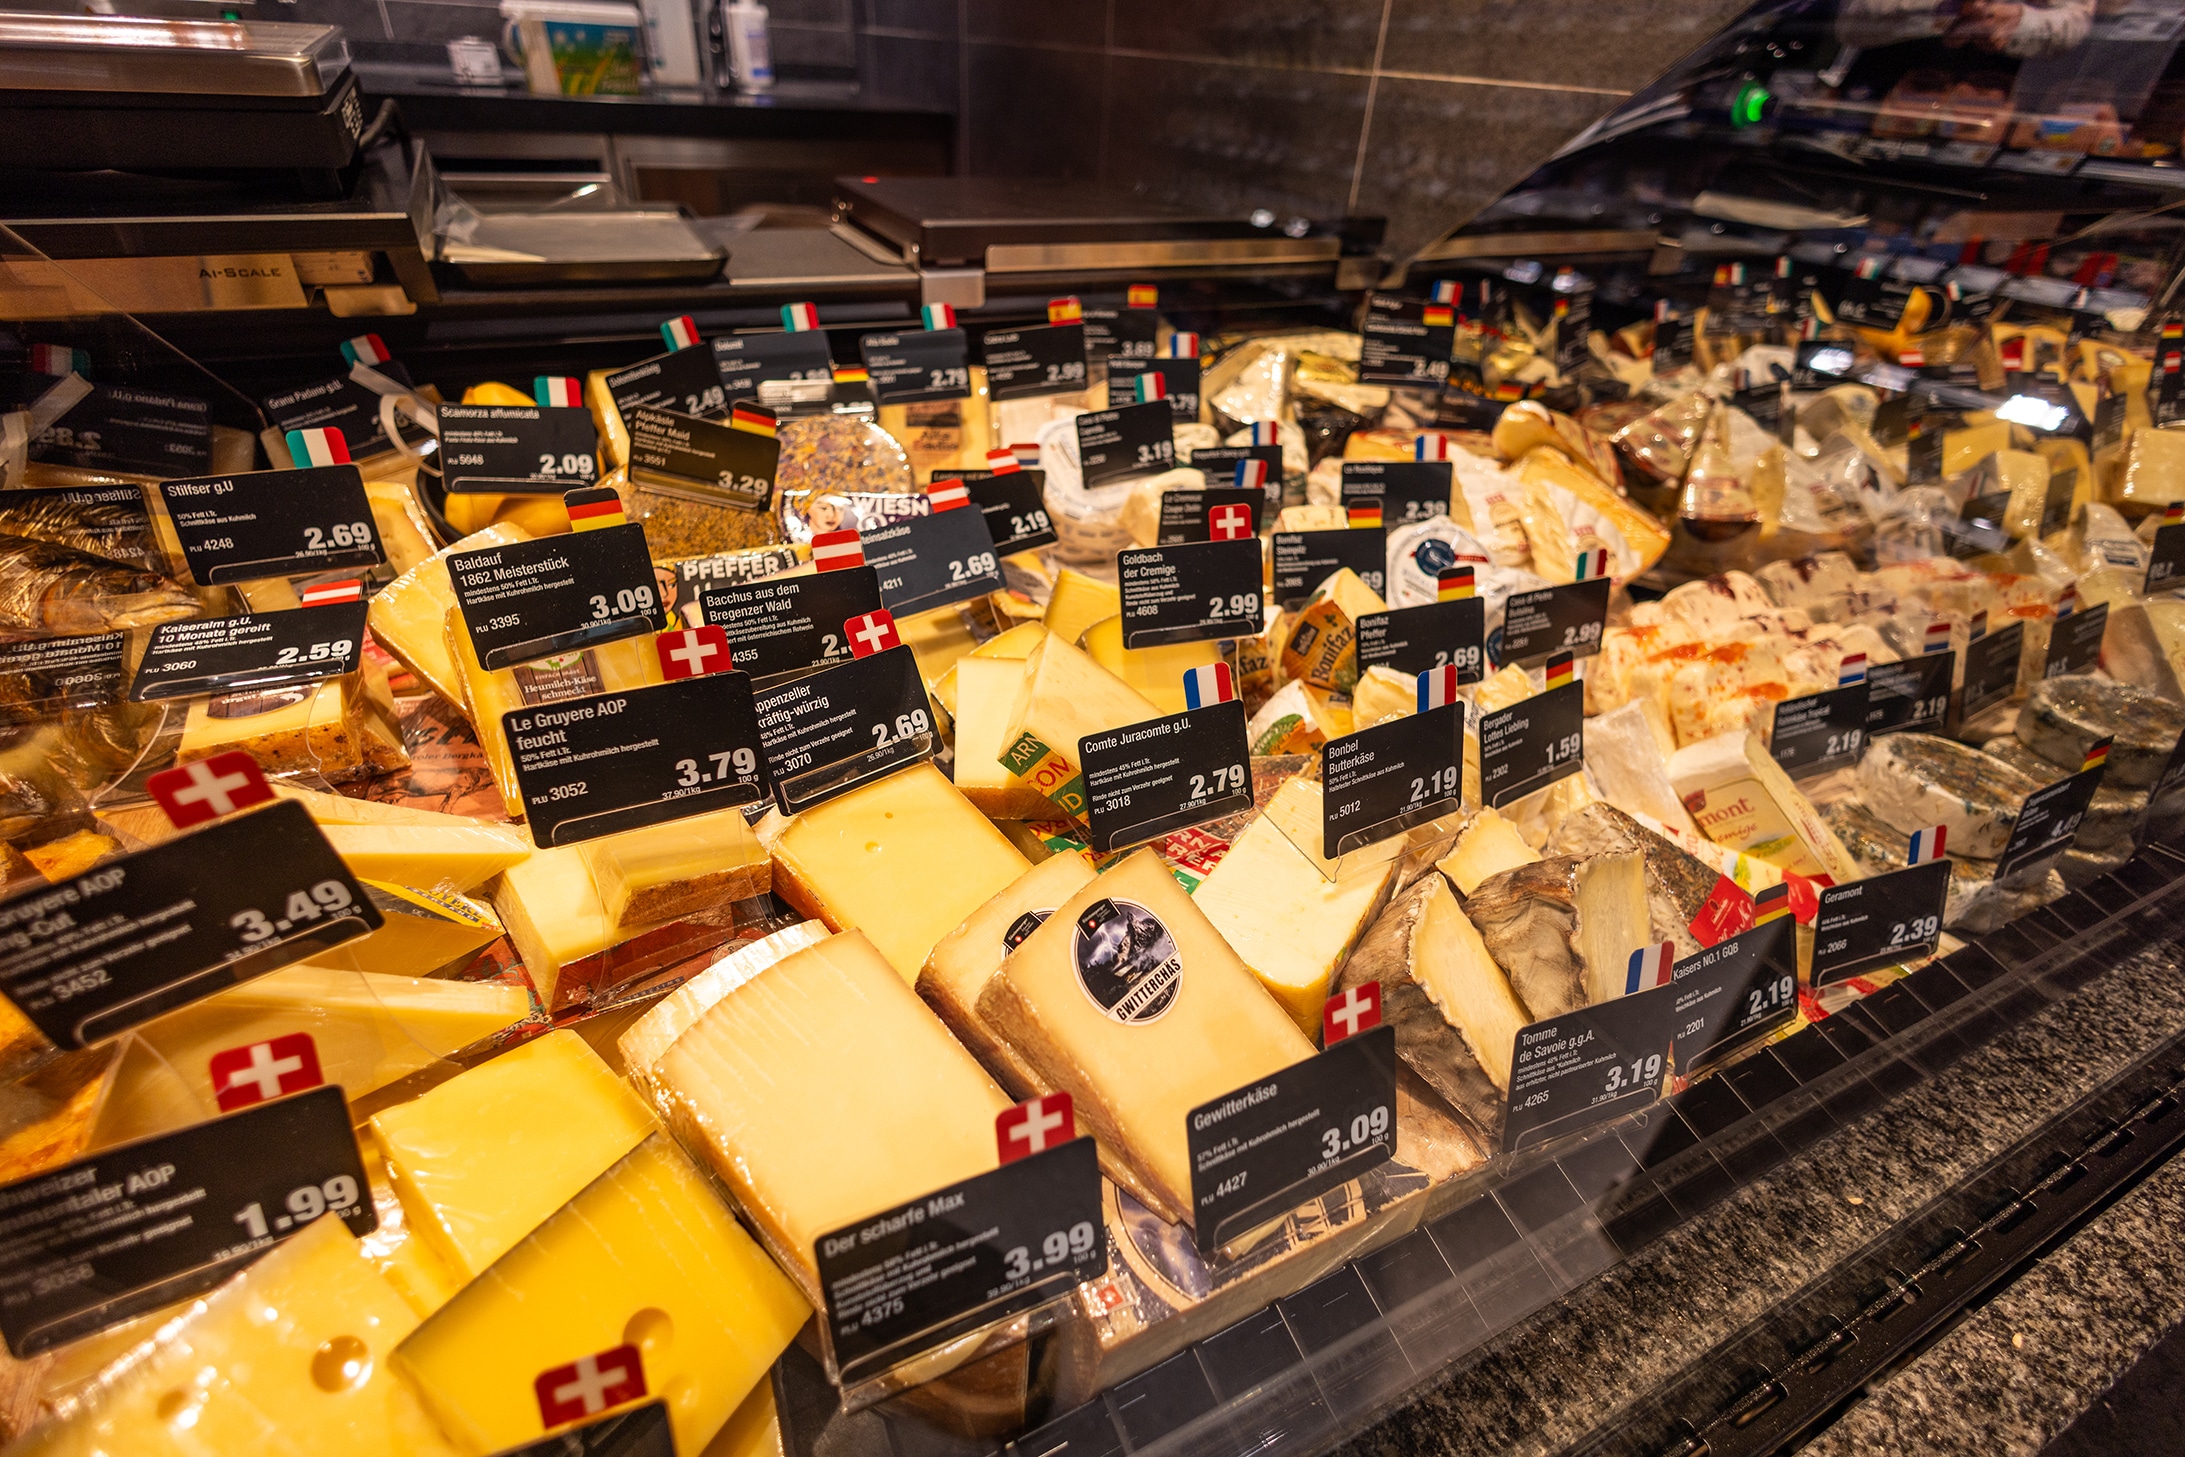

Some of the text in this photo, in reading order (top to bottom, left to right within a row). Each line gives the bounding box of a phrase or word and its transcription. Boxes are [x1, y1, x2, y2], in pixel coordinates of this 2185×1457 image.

[930, 367, 968, 387] 2.79
[1046, 361, 1085, 382] 2.99
[440, 406, 541, 420] Scamorza affumicata
[540, 453, 594, 475] 2.09
[1137, 440, 1173, 464] 3.19
[167, 480, 235, 498] Stilfser g.U
[719, 470, 769, 496] 3.29
[851, 495, 930, 518] WIESN
[1405, 500, 1448, 520] 2.39
[1010, 510, 1050, 535] 2.19
[203, 537, 234, 551] 4248
[304, 521, 373, 550] 2.69
[454, 552, 503, 572] Baldauf
[459, 556, 570, 586] 1862 Meisterstück
[682, 556, 780, 582] PFEFFER
[948, 551, 997, 582] 2.69
[1122, 552, 1164, 566] Goldbach
[1124, 564, 1177, 579] der Cremige
[705, 590, 754, 608] Bacchus
[754, 588, 775, 600] aus
[776, 583, 800, 596] dem
[882, 577, 904, 591] 4211
[589, 585, 655, 619] 3.09
[708, 598, 792, 623] Bregenzer Wald
[1136, 604, 1159, 617] 4608
[1209, 593, 1259, 619] 2.99
[158, 622, 271, 644] 10 Monate gereift
[160, 616, 252, 635] Kaiseralm g.U.
[475, 612, 521, 634] PLU 3395
[1563, 620, 1603, 646] 2.99
[275, 640, 353, 666] 2.59
[731, 648, 759, 665] 4355
[1311, 626, 1354, 682] Bonifaz
[1434, 645, 1481, 669] 2.69
[162, 660, 198, 672] 3060
[524, 675, 598, 694] Heumilch-Käse
[541, 685, 587, 701] schmeckt
[511, 699, 627, 732] Le Gruyere AOP
[1913, 694, 1947, 720] 2.19
[871, 708, 931, 750] 2.69
[1483, 711, 1513, 731] Bergader
[1504, 717, 1530, 737] Liebling
[516, 728, 568, 751] feucht
[1084, 717, 1192, 755] Comte Juracomte g.U.
[1545, 731, 1581, 764] 1.59
[1825, 728, 1862, 755] 2.19
[523, 738, 660, 772] Hartkäse mit Kuhrohmilch hergestellt
[1328, 739, 1360, 760] Bonbel
[675, 747, 757, 788] 3.79
[772, 752, 813, 778] PLU 3070
[1328, 750, 1375, 776] Butterkäse
[1492, 763, 1509, 779] 2302
[737, 774, 753, 785] 100
[1189, 764, 1246, 800] 2.79
[1410, 765, 1458, 803] 2.19
[532, 780, 589, 806] PLU 3052
[661, 785, 702, 802] 37.90/1kg
[1094, 794, 1132, 817] PLU 3018
[1179, 798, 1207, 812] 27.90/1kg
[1339, 799, 1361, 818] 5012
[78, 866, 127, 900] AOP
[1824, 884, 1863, 905] Geramont
[229, 878, 353, 944] 3.49
[1890, 915, 1938, 946] 2.39
[1672, 949, 1720, 981] Kaisers NO.1
[1116, 957, 1181, 1021] GWITTERCHÄS
[1749, 975, 1794, 1015] 2.19
[1521, 1026, 1558, 1047] Tomme
[1686, 1017, 1705, 1036] 2201
[1518, 1029, 1596, 1065] de Savoie g.g.A.
[1604, 1053, 1661, 1093] 3.19
[1643, 1079, 1653, 1089] 100
[1193, 1082, 1279, 1132] Gewitterkäse
[1511, 1089, 1550, 1114] PLU 4265
[1590, 1090, 1618, 1106] 31.90/1kg
[1320, 1104, 1390, 1161] 3.09
[1371, 1134, 1383, 1146] 100
[126, 1161, 177, 1195] AOP
[1306, 1155, 1340, 1179] 30.90/1kg
[1215, 1170, 1248, 1199] 4427
[233, 1173, 361, 1239] 1.99
[823, 1191, 966, 1259] Der scharfe Max
[1003, 1220, 1096, 1281] 3.99
[1072, 1250, 1089, 1266] 100
[985, 1275, 1031, 1300] 39.90/1kg
[860, 1296, 905, 1328] 4375
